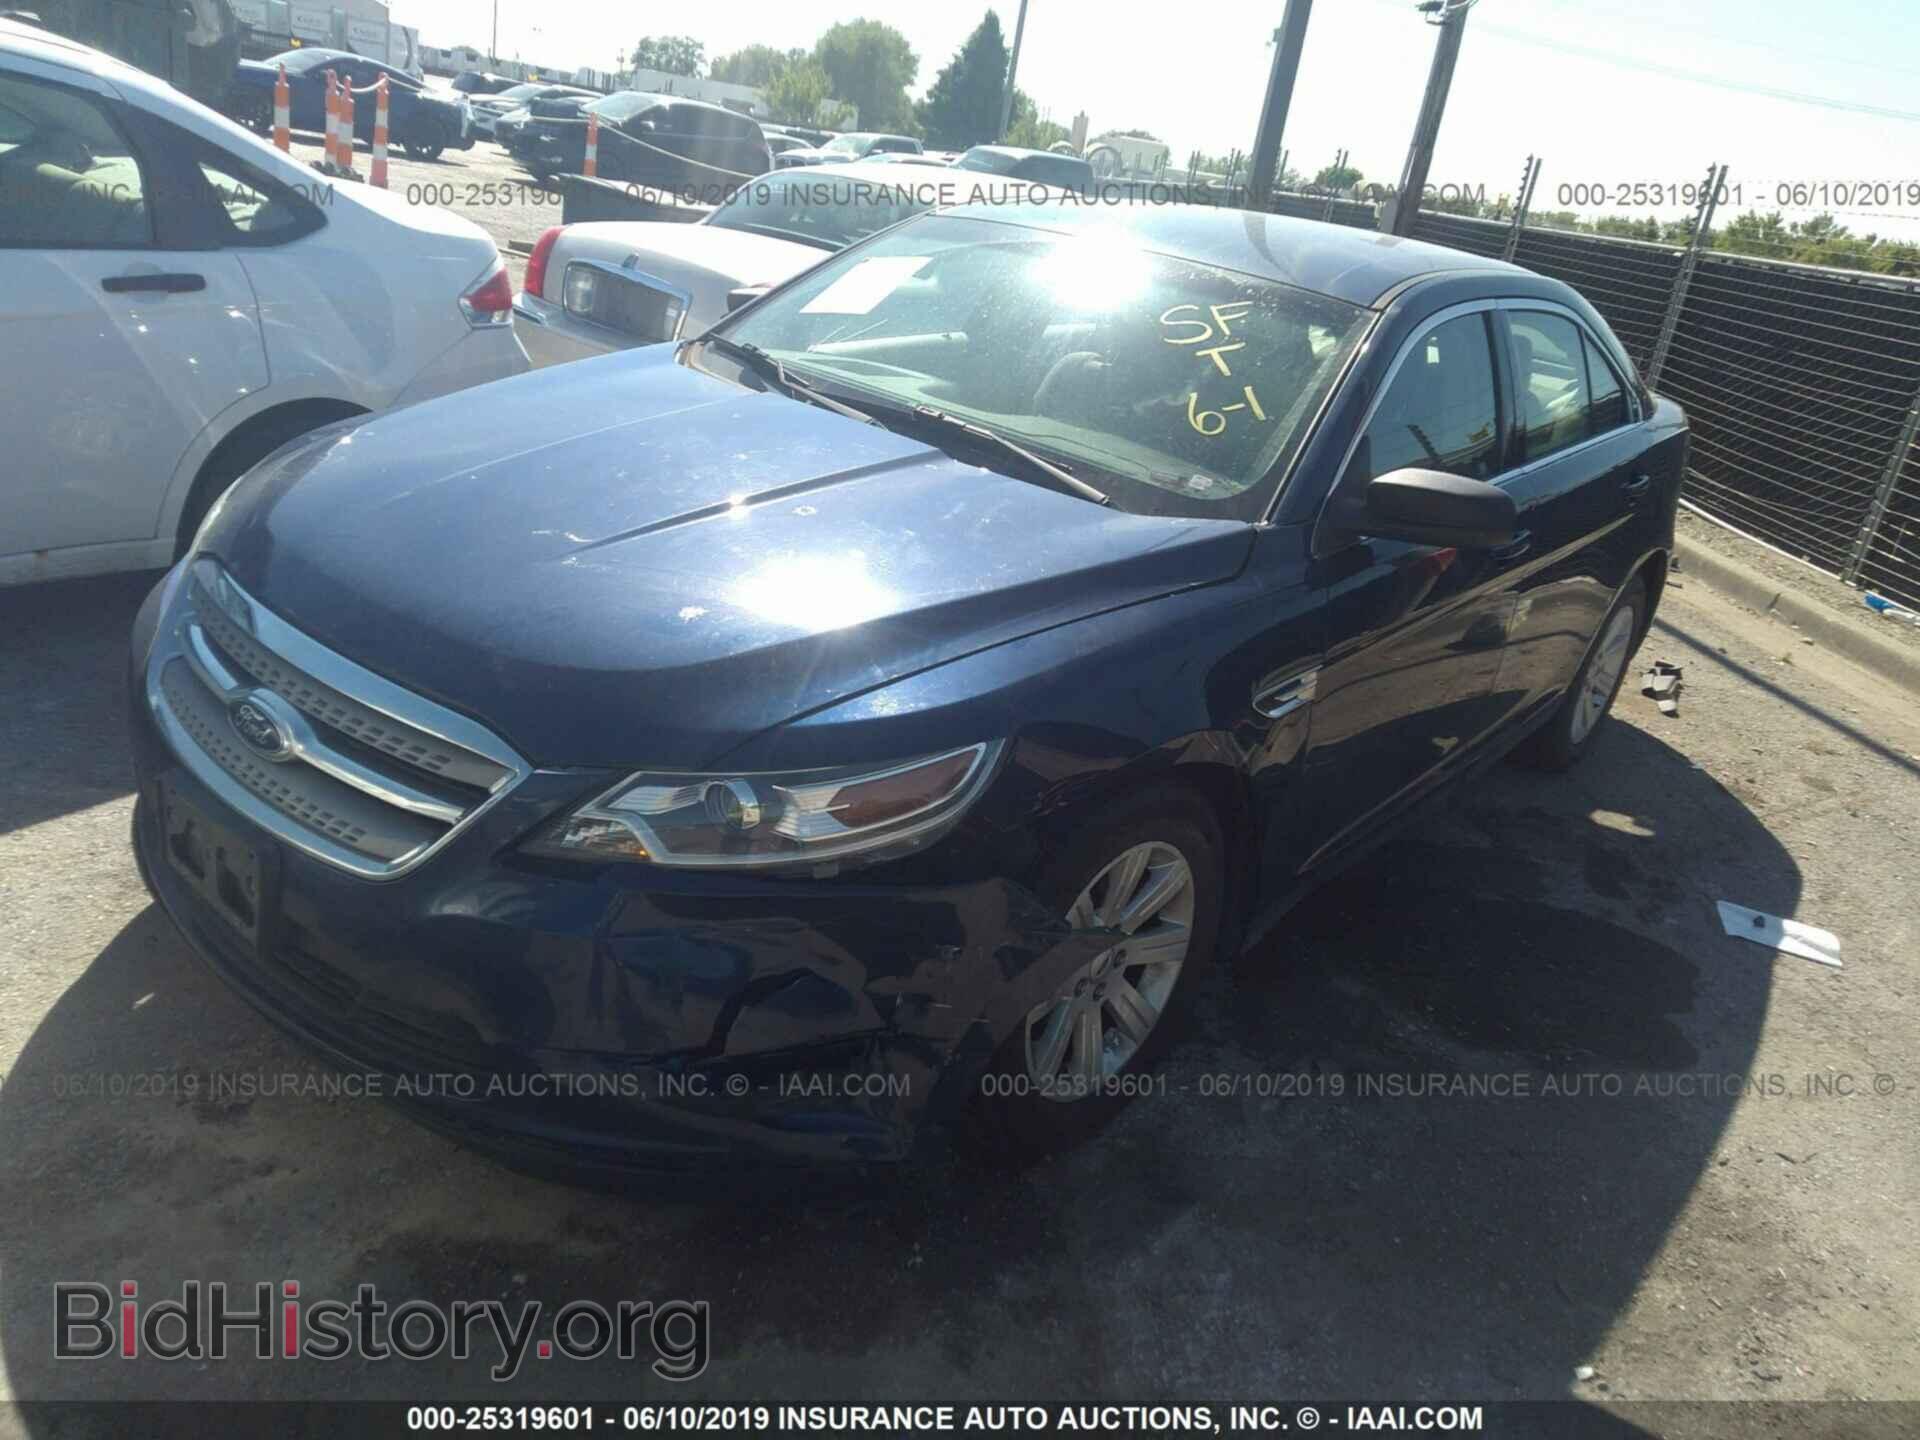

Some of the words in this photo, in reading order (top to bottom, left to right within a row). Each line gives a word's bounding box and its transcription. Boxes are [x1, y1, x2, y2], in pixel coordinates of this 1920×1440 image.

[1160, 301, 1254, 344] SF
[1195, 342, 1246, 376] T
[1187, 386, 1266, 435] 6-1
